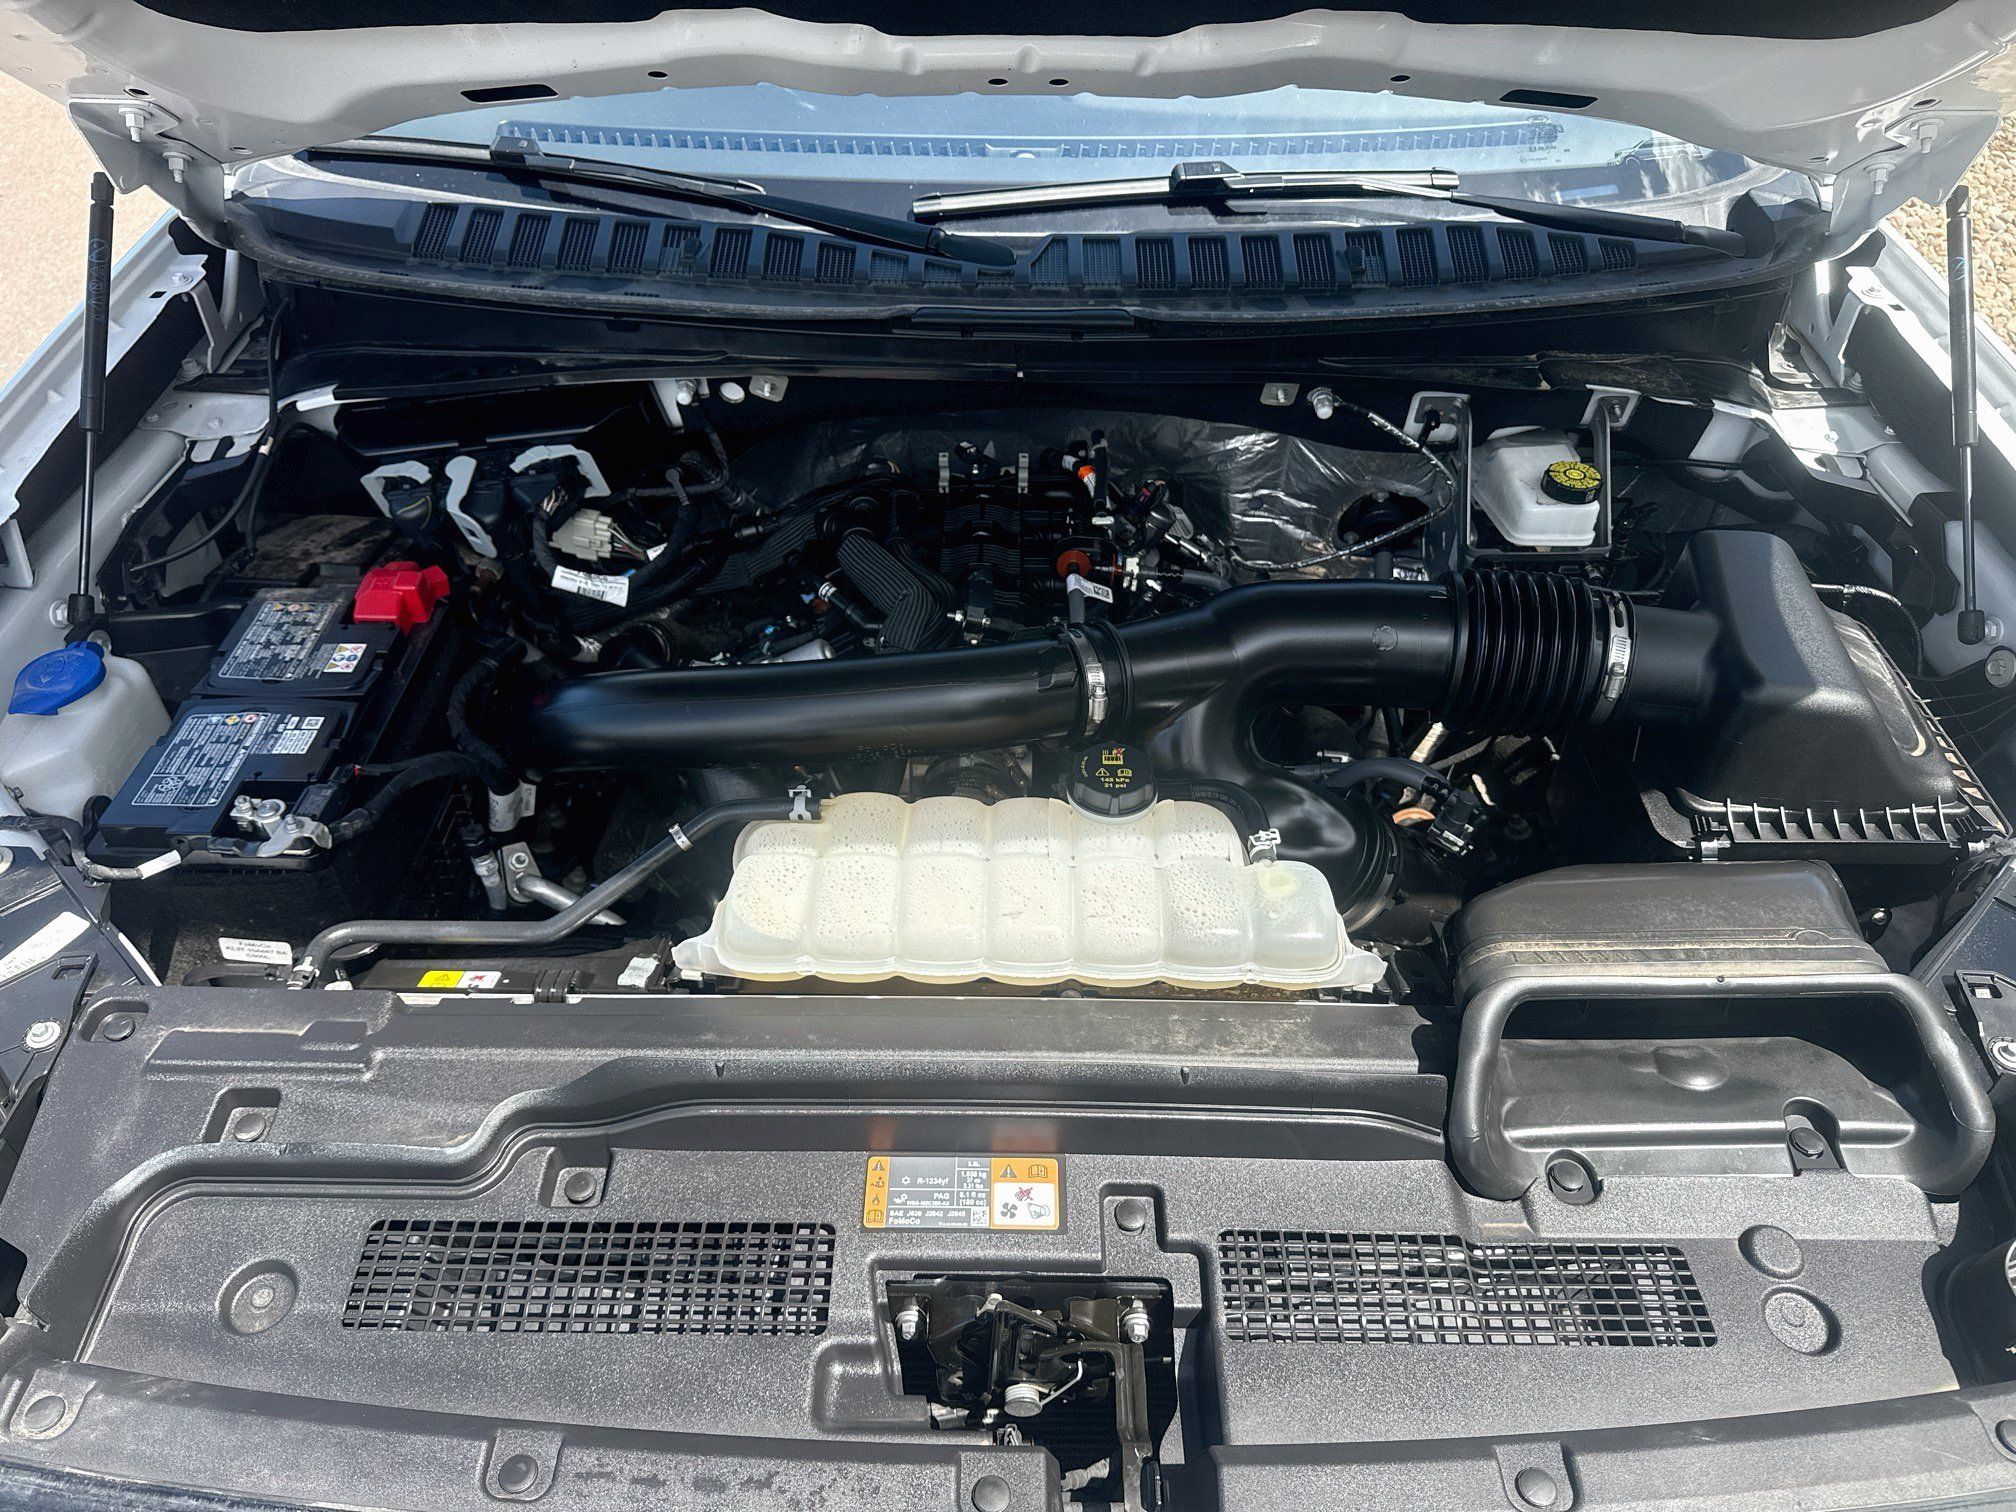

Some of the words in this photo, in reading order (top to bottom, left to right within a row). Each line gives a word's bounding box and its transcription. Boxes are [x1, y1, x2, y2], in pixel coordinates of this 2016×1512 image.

[978, 1170, 987, 1180] kg
[917, 1177, 949, 1186] R-1234yf
[933, 1192, 950, 1200] PAG
[888, 1216, 921, 1225] FoMoCo
